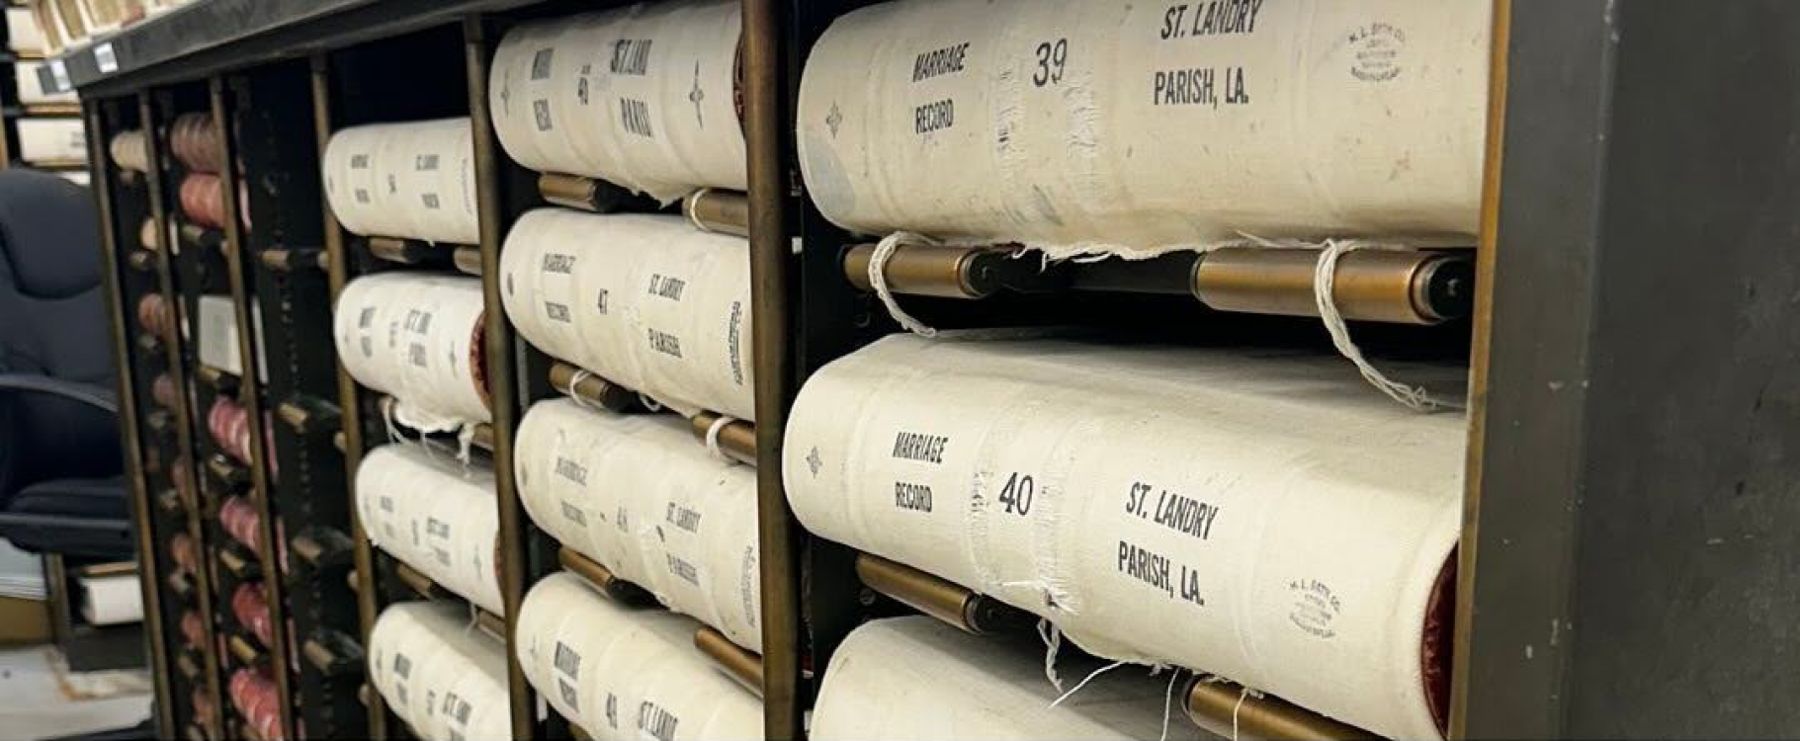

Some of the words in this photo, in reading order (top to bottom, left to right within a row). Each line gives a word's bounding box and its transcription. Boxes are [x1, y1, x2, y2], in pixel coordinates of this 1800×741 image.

[1160, 4, 1188, 40] ST.
[1192, 0, 1263, 36] LANDRY
[912, 42, 970, 82] MARRIAGE
[1033, 38, 1068, 88] 39
[1154, 68, 1218, 110] PARISH,
[1225, 66, 1249, 105] LA.
[915, 99, 954, 134] RECORD
[892, 432, 949, 464] MARRIAGE
[895, 482, 933, 513] RECORD
[999, 472, 1034, 516] 40
[1126, 481, 1152, 518] ST.
[1154, 490, 1218, 540] LANDRY
[1118, 540, 1174, 599] PARISH,
[1181, 564, 1205, 605] LA.
